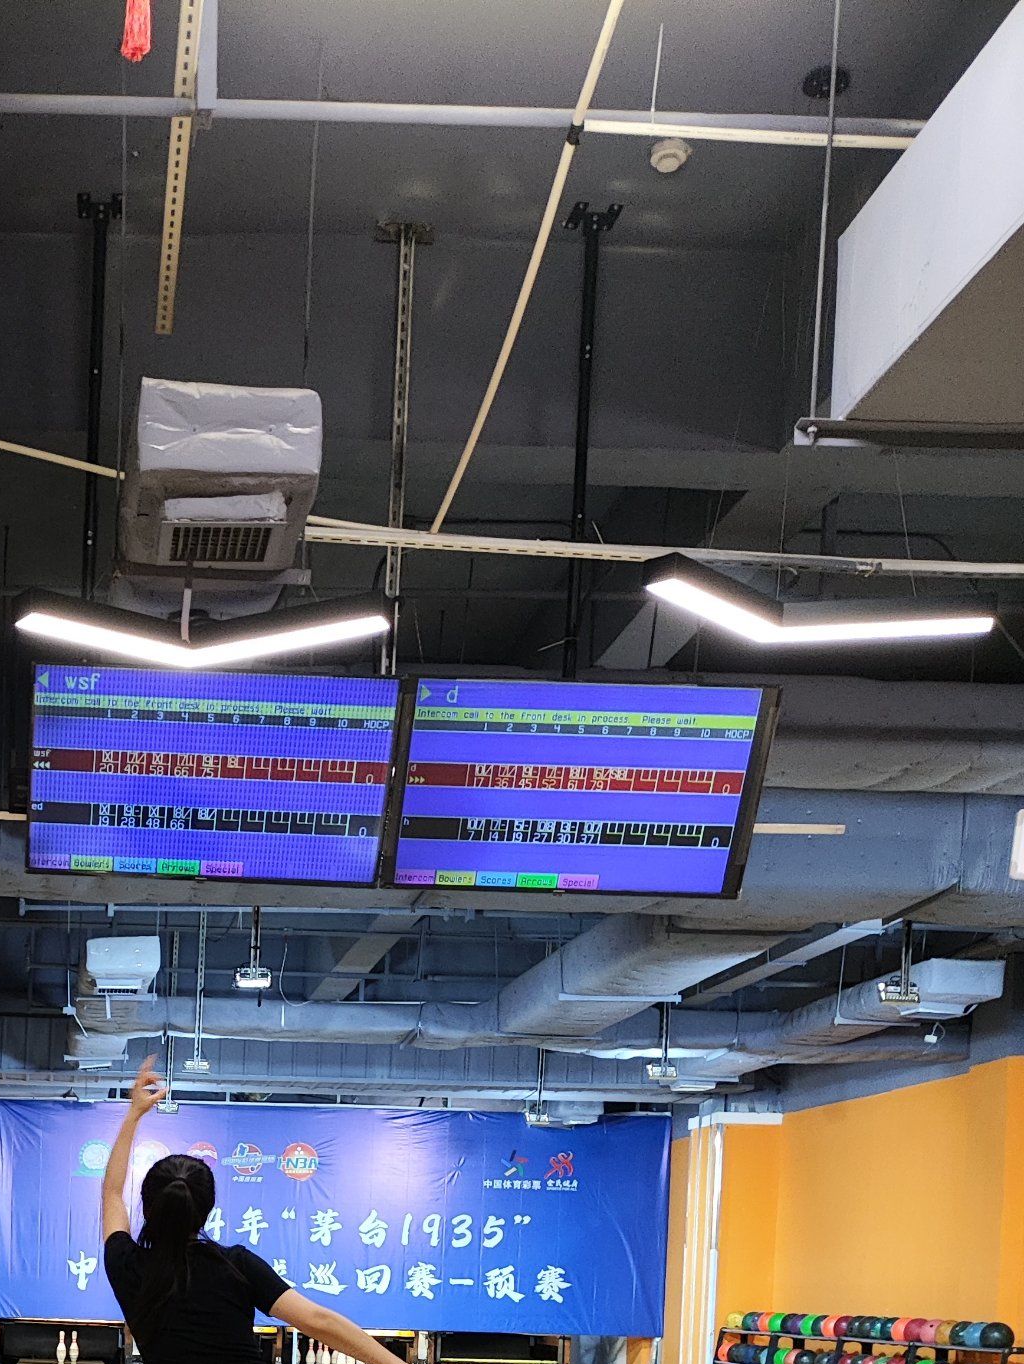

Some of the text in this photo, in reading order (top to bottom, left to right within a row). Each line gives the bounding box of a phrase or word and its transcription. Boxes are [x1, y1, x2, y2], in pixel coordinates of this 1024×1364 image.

[65, 673, 100, 690] wsf
[446, 685, 458, 703] d
[131, 710, 138, 719] 2
[157, 711, 164, 720] 3
[181, 712, 189, 721] 4
[207, 713, 215, 722] 5
[232, 715, 240, 724] 6
[259, 716, 265, 725] 7
[283, 716, 291, 726] 8
[309, 718, 317, 727] 9
[337, 719, 348, 728] 10
[417, 708, 458, 719] Intercom
[500, 711, 515, 720] the
[552, 712, 573, 722] desk
[577, 713, 587, 722] in
[642, 715, 671, 725] Please
[506, 723, 514, 732] 2
[530, 724, 537, 733] 3
[554, 724, 561, 733] 4
[577, 725, 585, 734] 5
[601, 726, 609, 735] 6
[626, 727, 633, 735] 7
[650, 727, 657, 736] 8
[674, 728, 681, 737] 9
[700, 729, 711, 738] 10
[99, 763, 374, 785] 20 40 58 66 75 0
[494, 777, 509, 788] 36
[518, 778, 533, 789] 45
[541, 779, 557, 789] 52
[567, 780, 578, 790] 61
[590, 780, 604, 790] 79
[723, 784, 730, 794] 0
[98, 815, 367, 838] 19 28 48 66 0
[468, 831, 719, 848] 7 14 19 27 30 37 0
[119, 860, 152, 871] Scores
[438, 874, 473, 884] Bowlers
[480, 876, 512, 885] Scores
[520, 876, 553, 886] Arrows
[563, 878, 595, 888] Special
